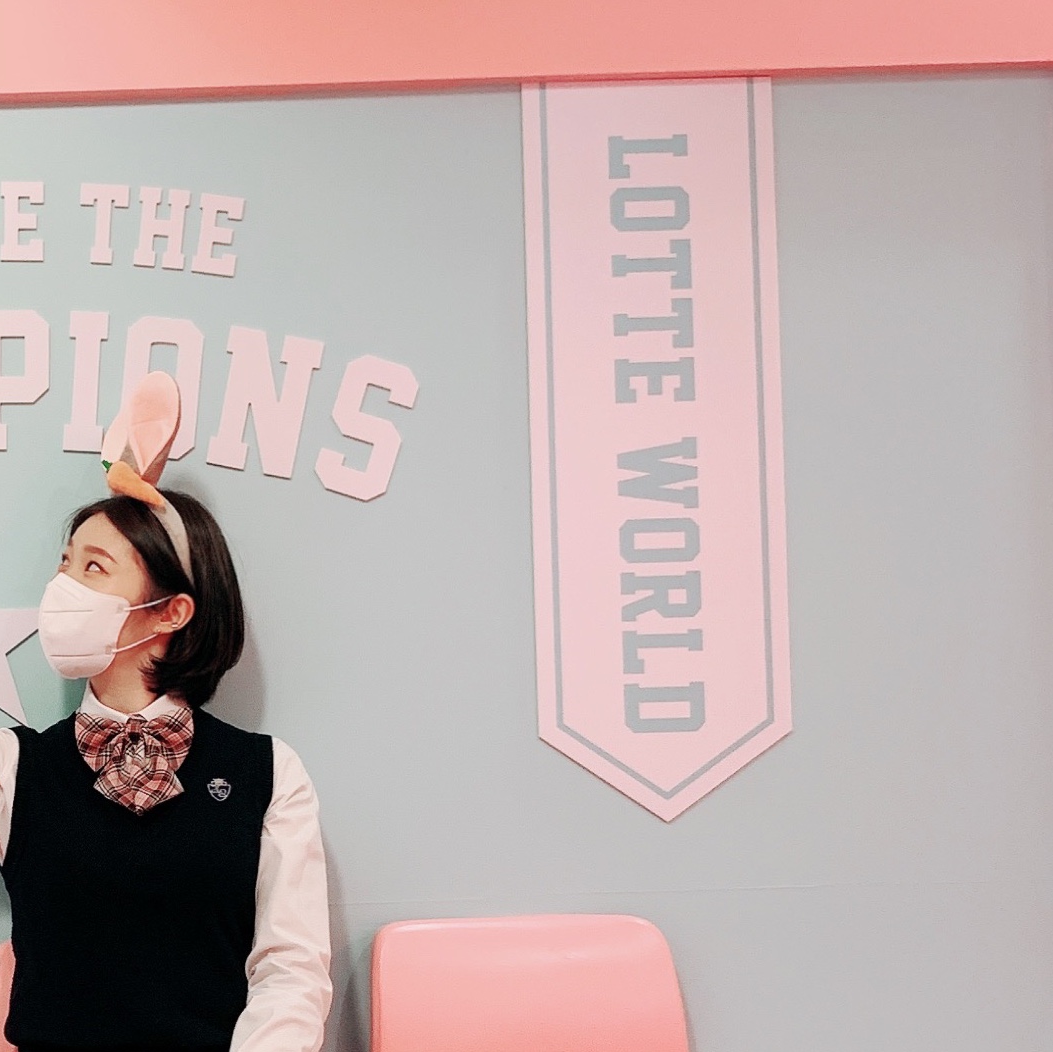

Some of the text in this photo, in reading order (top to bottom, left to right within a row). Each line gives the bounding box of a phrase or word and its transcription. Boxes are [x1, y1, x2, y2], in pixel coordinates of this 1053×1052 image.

[79, 181, 245, 277] THE
[608, 134, 705, 734] LOTTE WORLD
